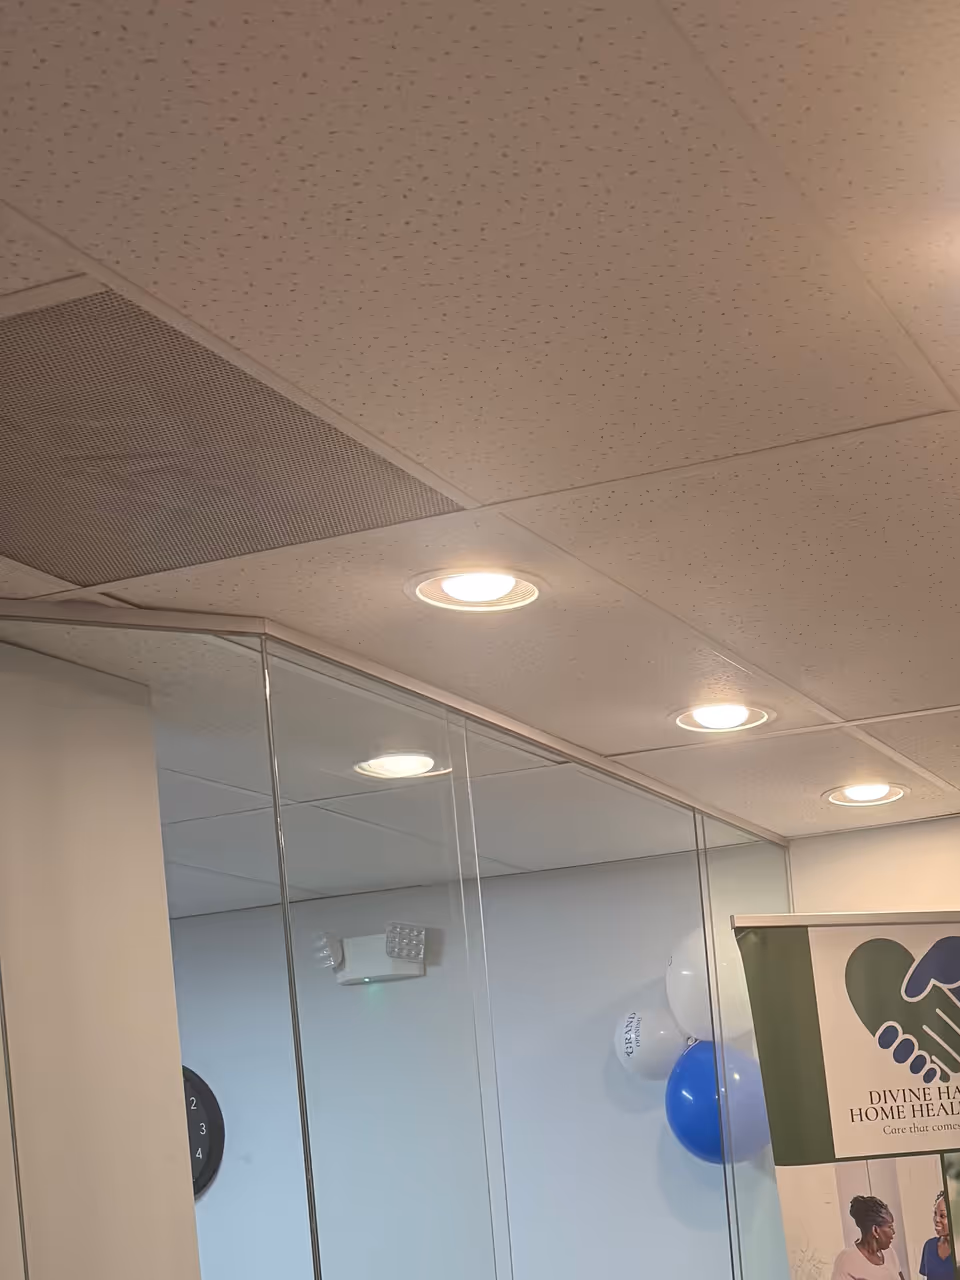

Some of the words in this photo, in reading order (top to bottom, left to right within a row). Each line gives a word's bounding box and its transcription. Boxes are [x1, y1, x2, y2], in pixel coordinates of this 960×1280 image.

[624, 1012, 636, 1057] GRAND
[190, 1097, 197, 1109] 2
[869, 1087, 932, 1106] DIVINE
[850, 1105, 906, 1123] HOME
[200, 1123, 206, 1135] 3
[883, 1125, 907, 1135] Care
[909, 1122, 929, 1133] that
[932, 1123, 960, 1132] comes
[195, 1148, 202, 1159] 4
